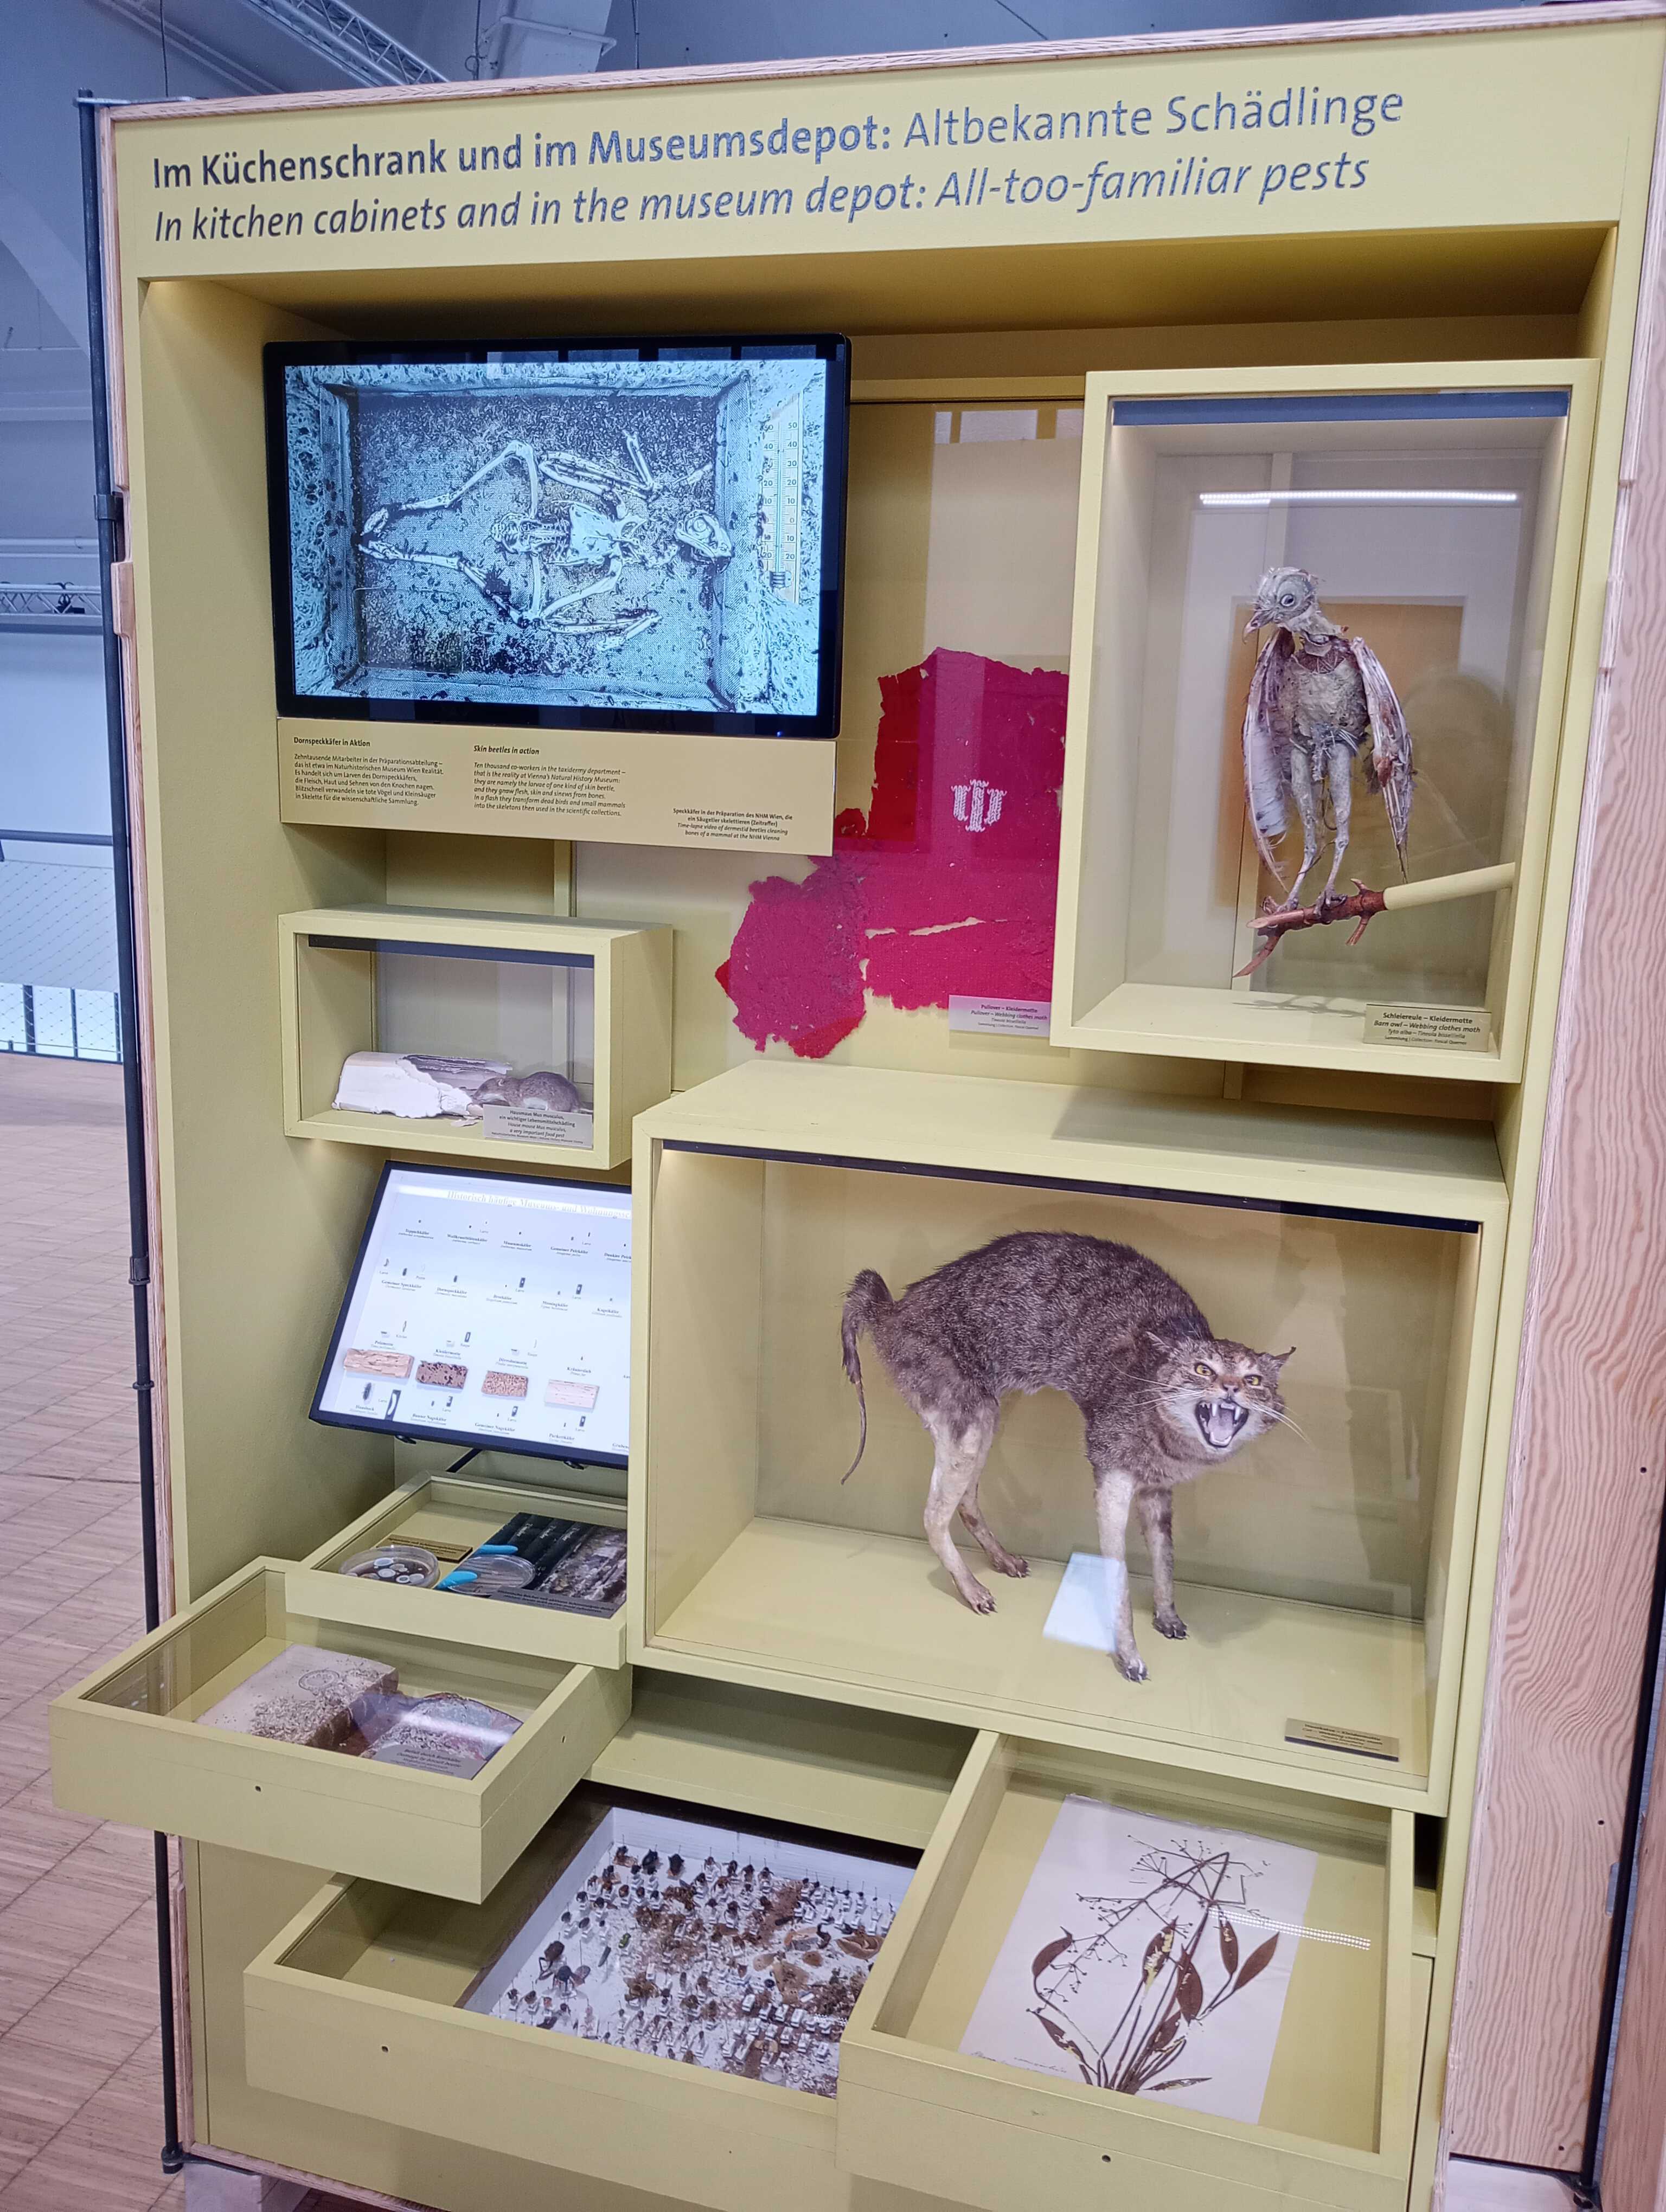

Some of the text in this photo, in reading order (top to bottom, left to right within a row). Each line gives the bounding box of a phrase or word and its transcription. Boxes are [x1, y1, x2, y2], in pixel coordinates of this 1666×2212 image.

[154, 87, 1402, 188] Im Küchenschrank und im Museumsdepot: Altbekannte Schädlinge
[156, 152, 1369, 241] In kitchen cabinets and in the museum depot: All-too-familiar pests
[293, 737, 341, 747] Dornspeckkäfer
[334, 763, 381, 771] Naturhistorischen
[379, 758, 438, 768] Präparationsabteilung
[558, 767, 587, 775] taxidermy
[587, 768, 620, 776] department
[373, 773, 417, 782] Dornspeckkäfers,
[502, 772, 520, 780] reality
[573, 775, 593, 784] History
[474, 779, 486, 787] they
[497, 780, 517, 788] namely
[377, 789, 392, 798] Vögel
[405, 791, 436, 800] Kleinsäuger
[388, 798, 419, 807] Sammlung.
[512, 797, 539, 805] transform
[1383, 1012, 1473, 1024] Schleiereule Kleidermotte
[1409, 1023, 1437, 1031] Webbing
